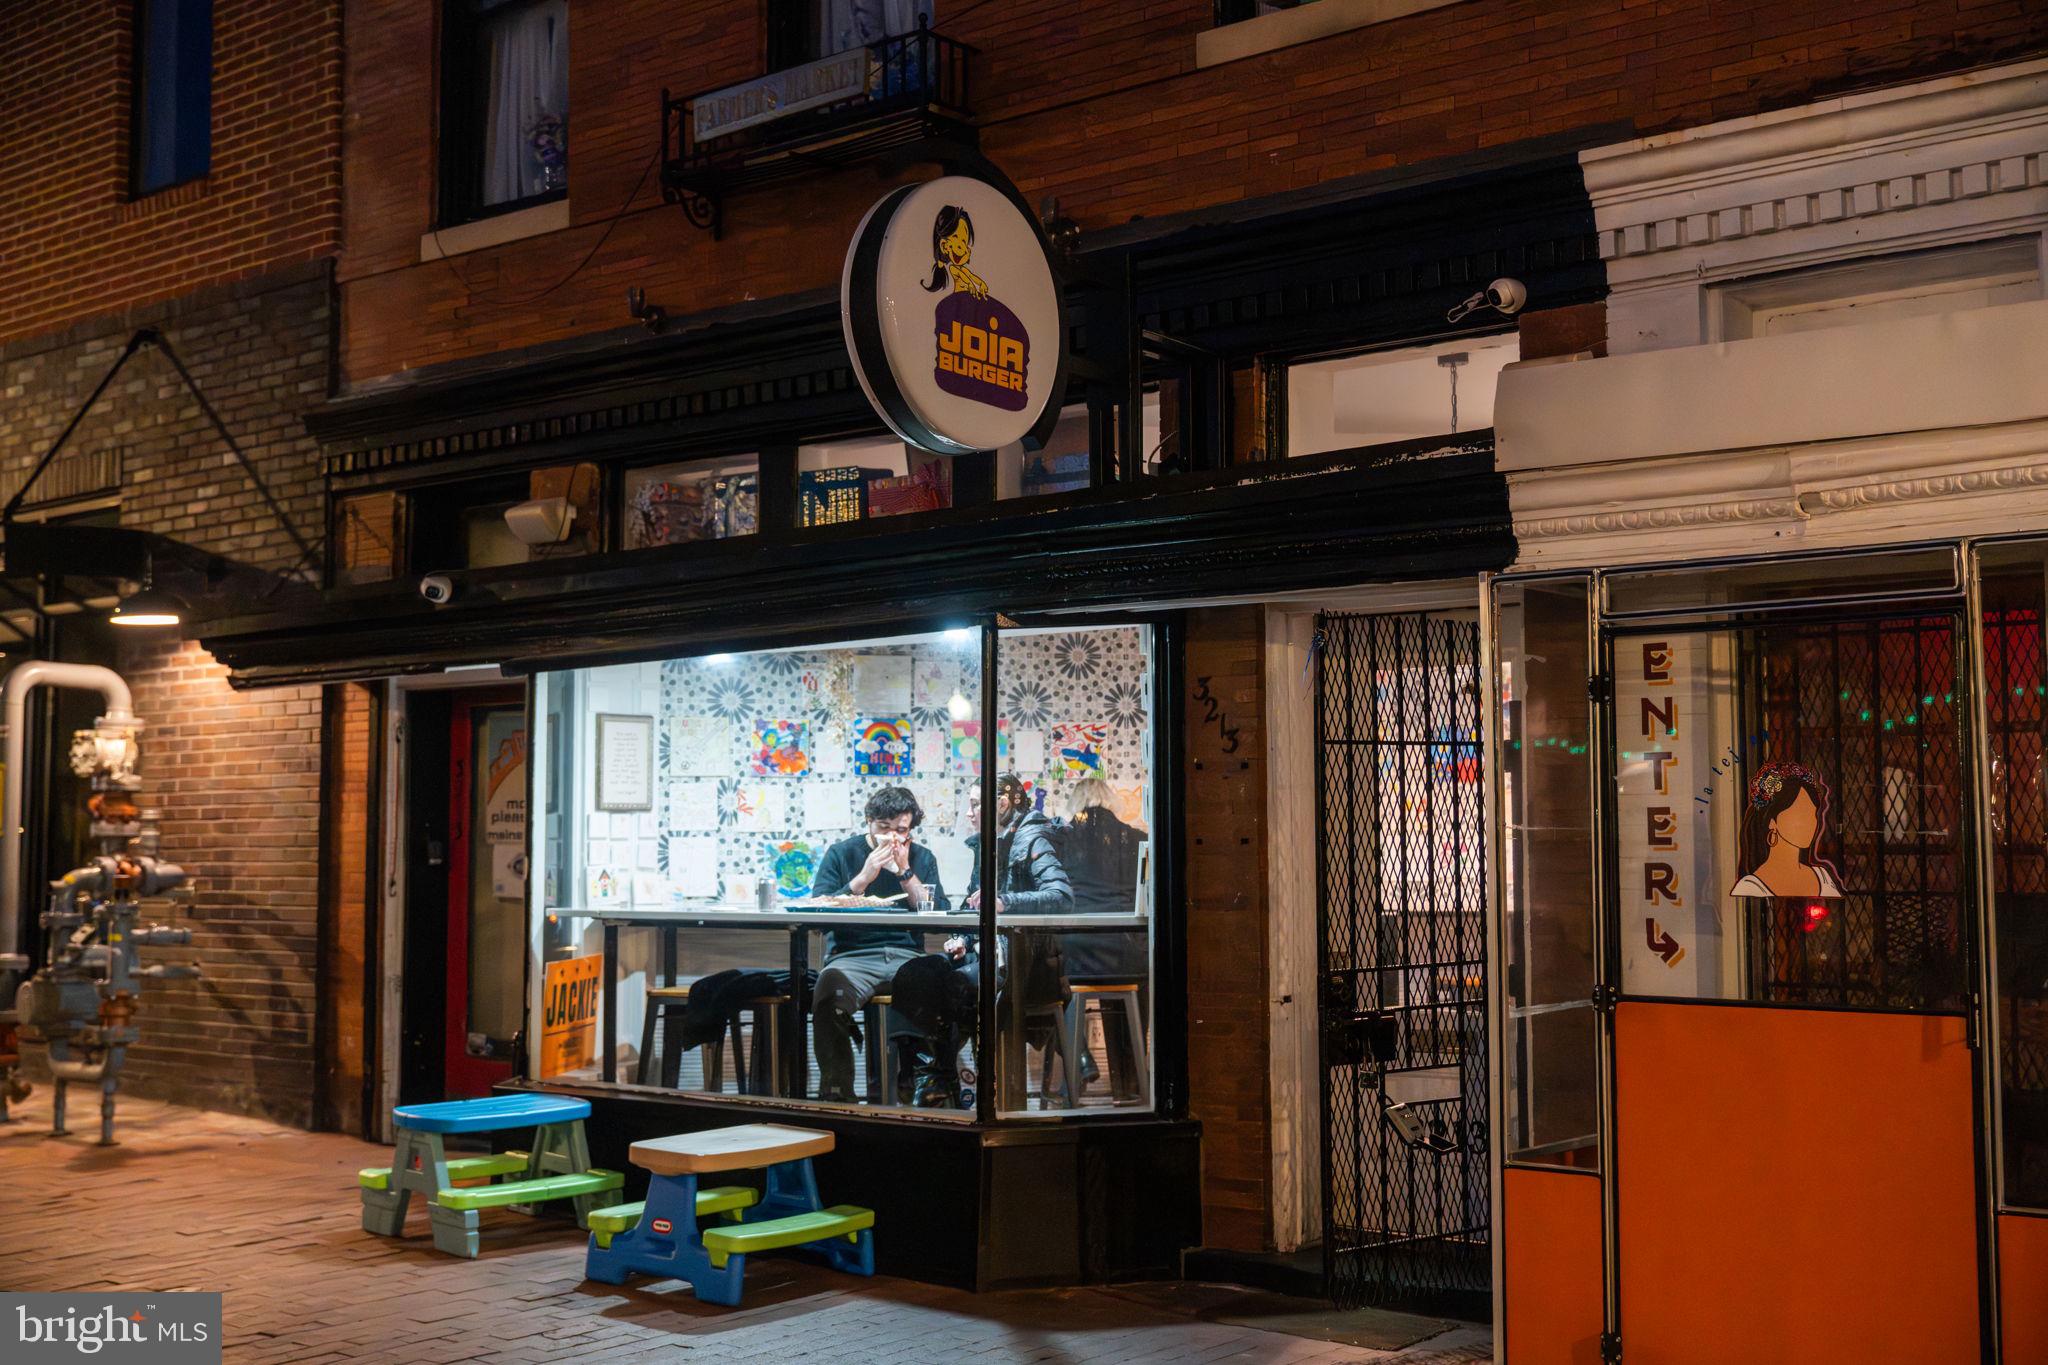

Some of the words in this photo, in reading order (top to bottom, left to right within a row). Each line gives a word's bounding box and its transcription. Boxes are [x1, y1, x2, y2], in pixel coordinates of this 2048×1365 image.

[939, 350, 1023, 393] BURGER
[1192, 676, 1240, 754] 3213
[1641, 642, 1682, 906] ENTER
[546, 976, 599, 1028] JACKIE
